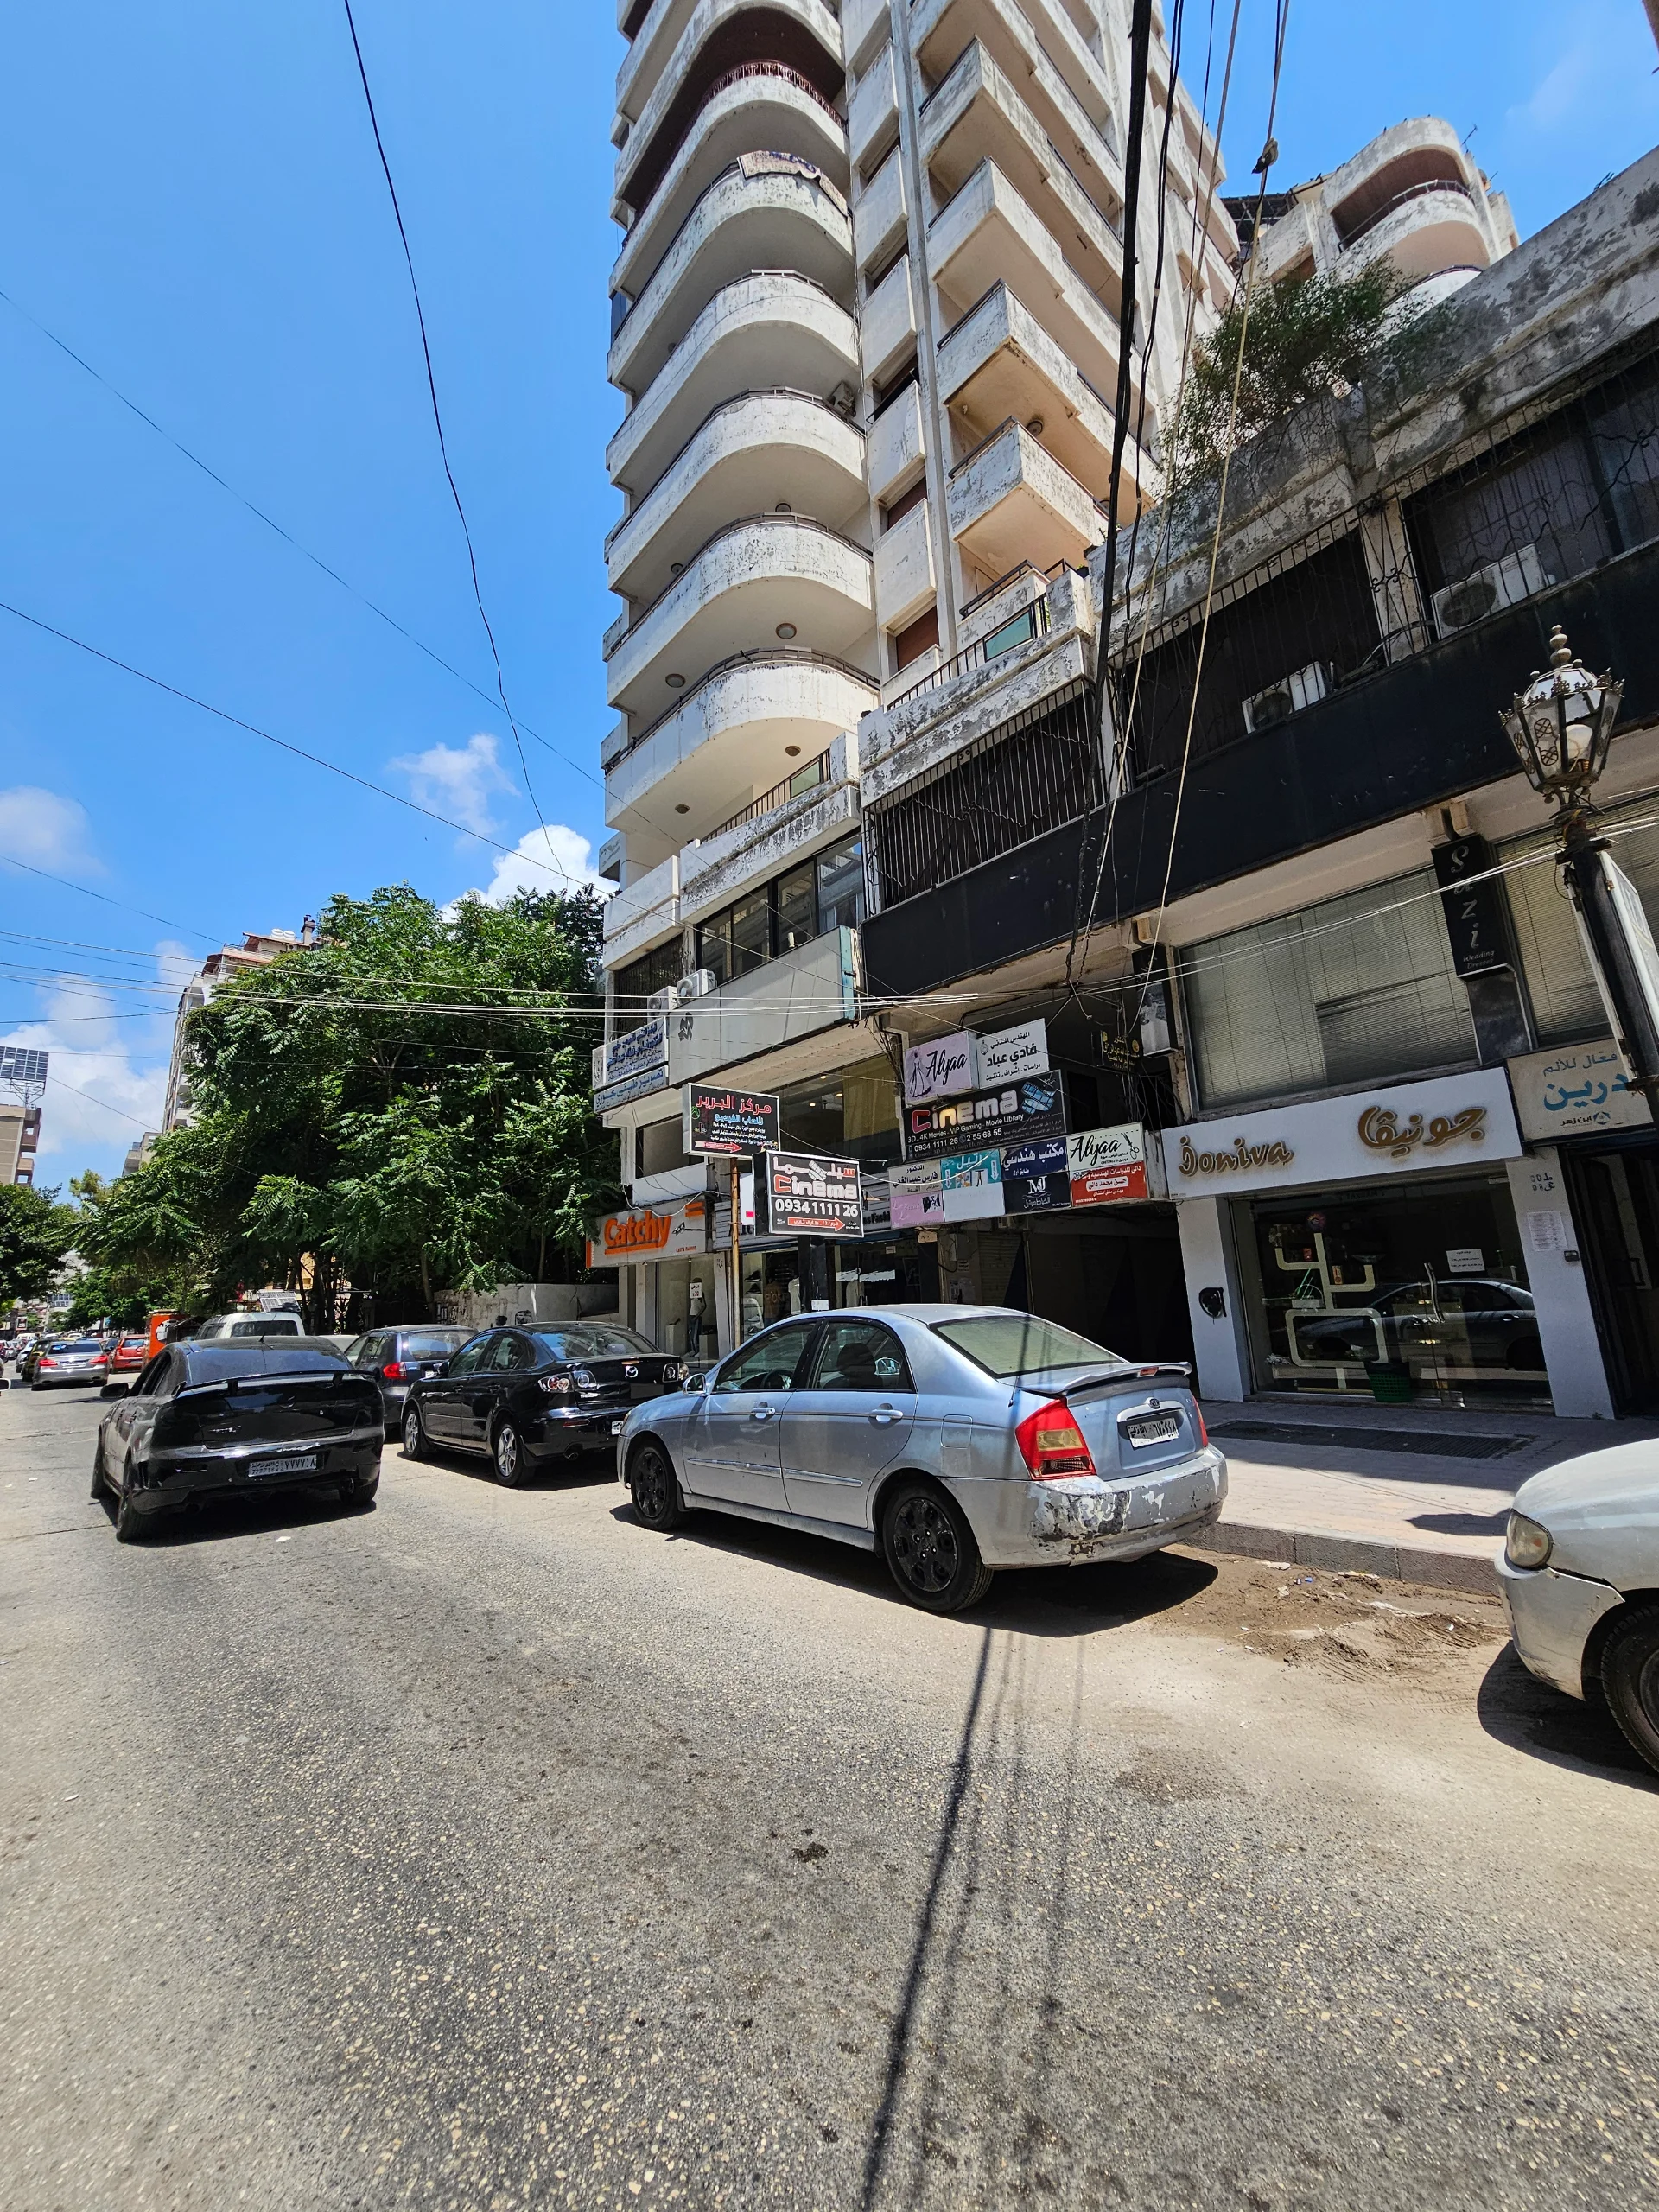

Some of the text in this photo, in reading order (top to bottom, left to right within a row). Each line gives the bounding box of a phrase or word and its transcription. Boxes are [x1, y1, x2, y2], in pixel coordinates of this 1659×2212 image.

[1463, 950, 1495, 962] Wedding
[987, 1043, 1038, 1067] فادي عباد
[926, 1049, 968, 1086] Alyaa
[1023, 1062, 1041, 1071] دراسات
[1543, 1073, 1630, 1111] درين
[739, 1097, 772, 1116] مركز
[961, 1122, 982, 1132] Gaming
[985, 1118, 1002, 1127] Movie
[1004, 1114, 1024, 1123] Library
[914, 1143, 931, 1152] 0934
[933, 1139, 947, 1148] 1111
[950, 1137, 958, 1146] 26
[993, 1128, 1002, 1136] 55
[1070, 1135, 1122, 1166] Alyaa
[1003, 1147, 1036, 1171] هندسي
[1038, 1142, 1065, 1163] مكتب
[905, 1165, 925, 1174] الدكتور
[921, 1171, 938, 1184] فارس
[775, 1198, 859, 1217] 0934 1111 26
[604, 1210, 672, 1249] Catchy
